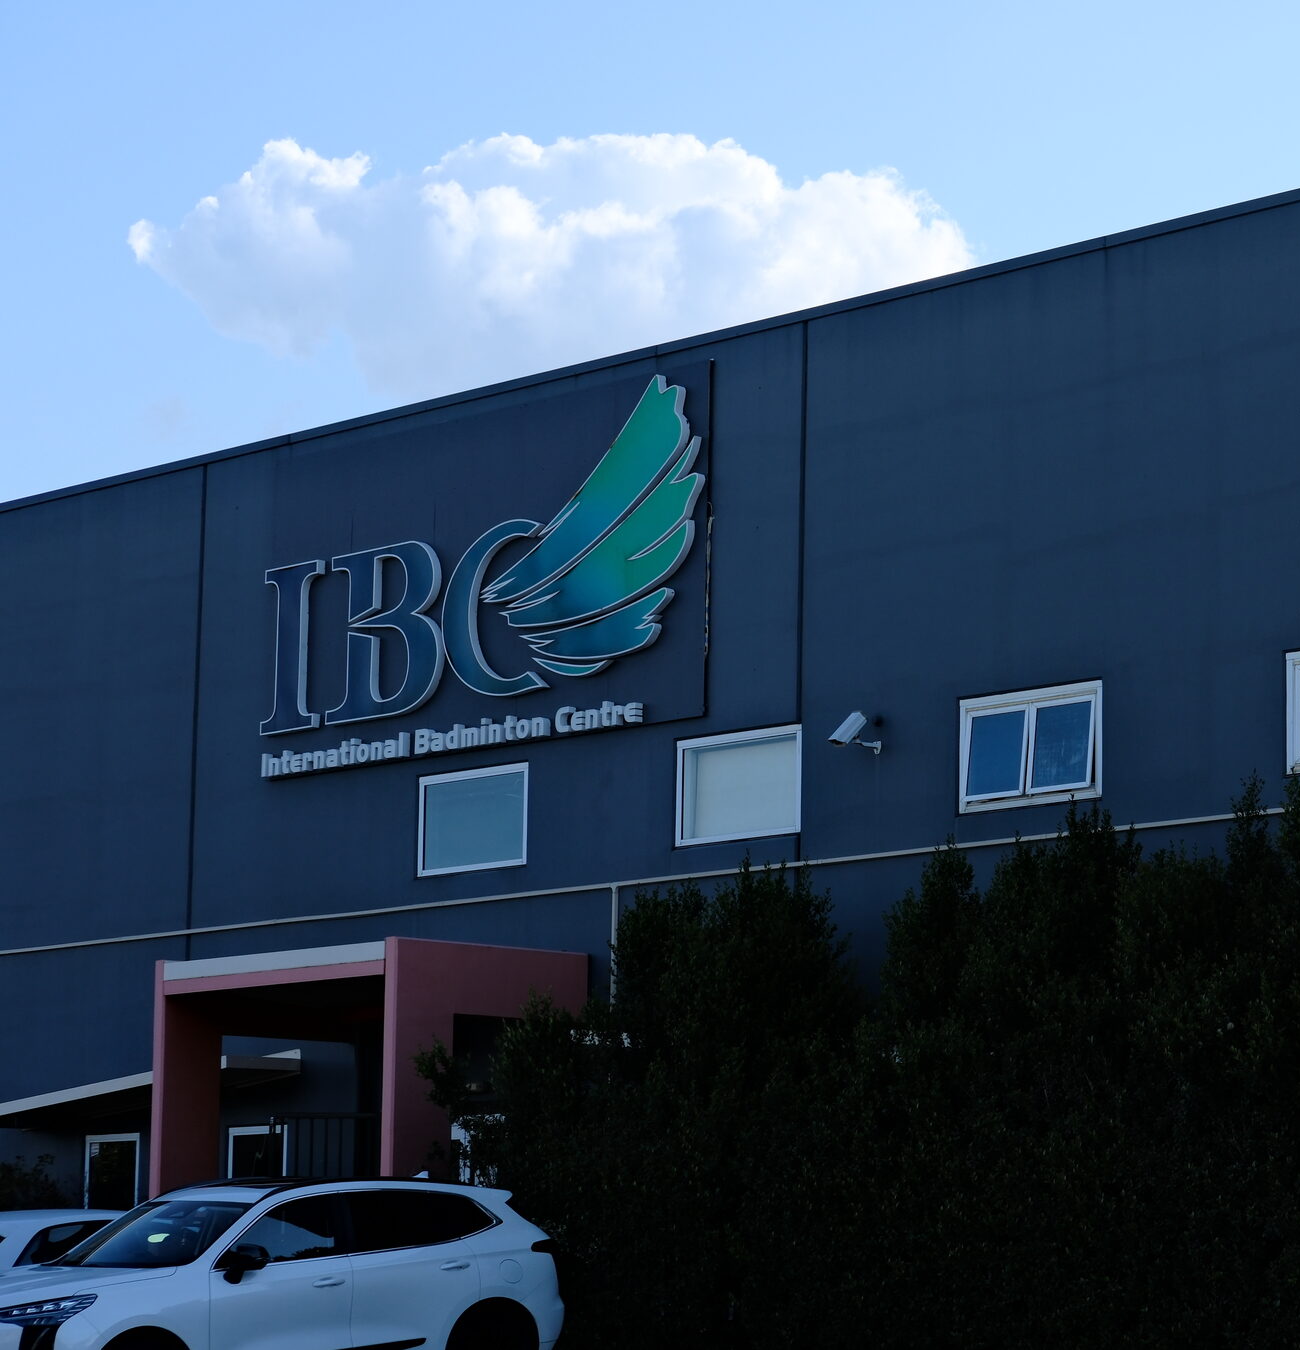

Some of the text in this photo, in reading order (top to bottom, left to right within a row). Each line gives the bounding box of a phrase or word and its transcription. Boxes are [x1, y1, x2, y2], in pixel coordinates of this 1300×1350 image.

[259, 518, 550, 736] IBC
[260, 701, 644, 777] International Badminton Centre
